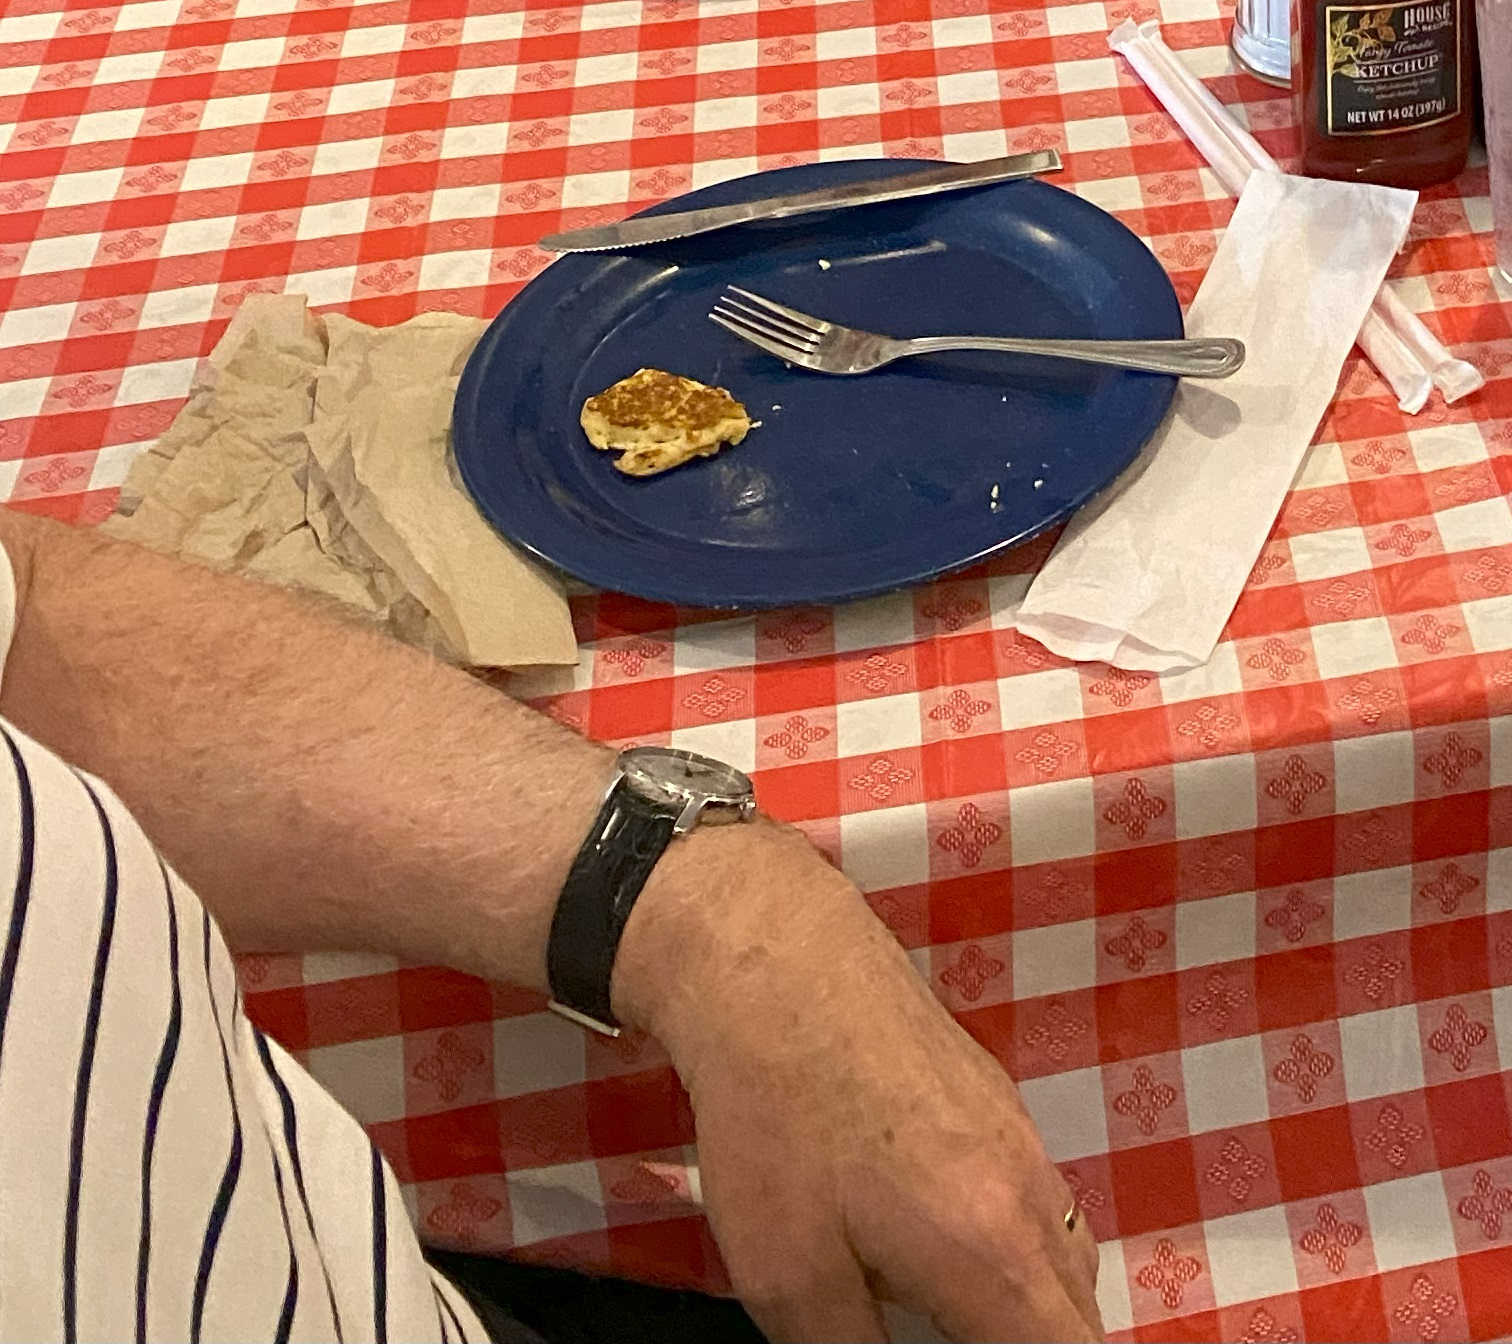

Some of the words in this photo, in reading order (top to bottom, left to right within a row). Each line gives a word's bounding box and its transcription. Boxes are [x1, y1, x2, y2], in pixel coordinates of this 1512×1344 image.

[1404, 1, 1450, 29] HOUSE
[1356, 54, 1439, 79] KETCHUP
[1347, 111, 1366, 123] NET
[1369, 109, 1385, 122] WT
[1388, 108, 1400, 120] 14
[1402, 105, 1414, 118] OZ
[1416, 96, 1446, 117] (397g)
